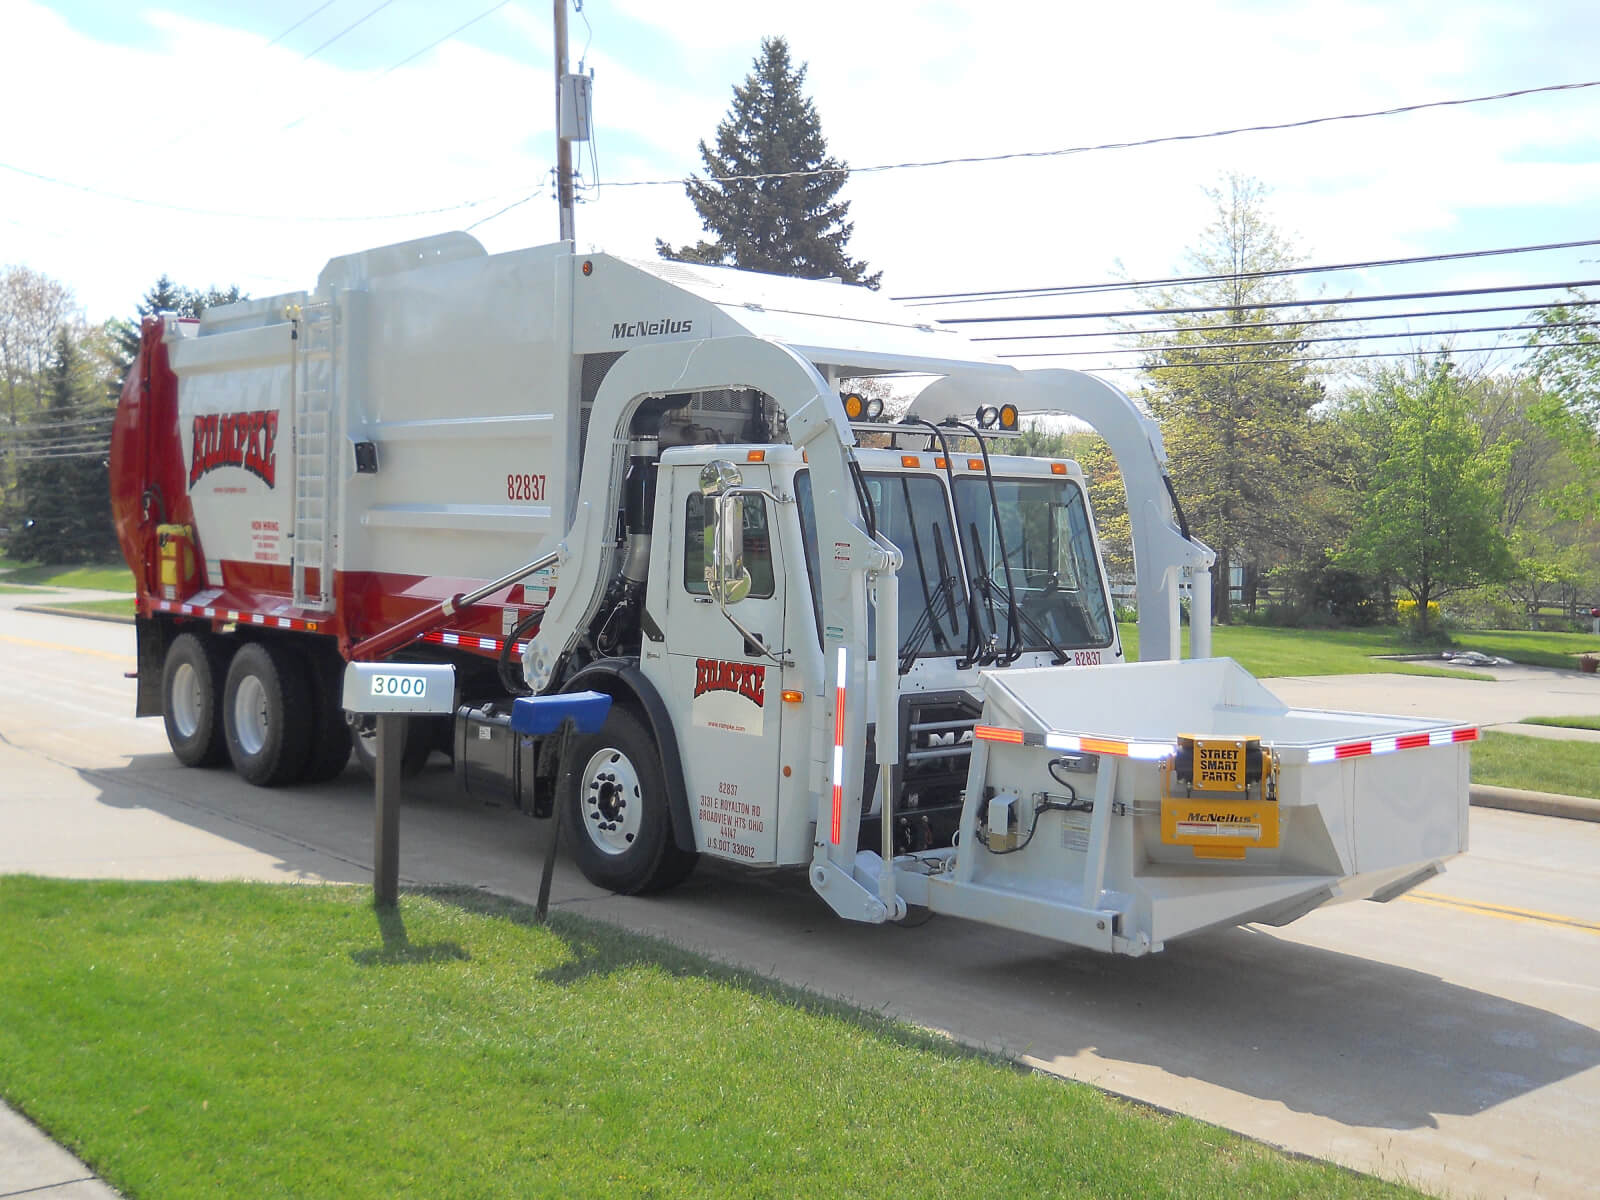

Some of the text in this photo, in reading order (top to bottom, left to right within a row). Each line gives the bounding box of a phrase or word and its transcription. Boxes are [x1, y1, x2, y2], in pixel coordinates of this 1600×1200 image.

[611, 319, 693, 339] McNeilus
[190, 409, 279, 489] RUMPKE
[507, 474, 546, 501] 82837
[1074, 651, 1101, 666] 82837
[374, 677, 424, 695] 3000
[694, 658, 766, 708] RUMPKE
[1200, 749, 1239, 760] STREET
[1200, 760, 1238, 771] SMART
[1201, 771, 1237, 782] PARTS
[719, 782, 738, 796] 82837
[700, 795, 761, 817] 3131 E ROYALTON RD
[699, 808, 764, 833] BROADVIEW HTS OHIO
[1187, 812, 1252, 823] McNeilus
[720, 826, 737, 840] 44147
[732, 842, 756, 859] 330912
